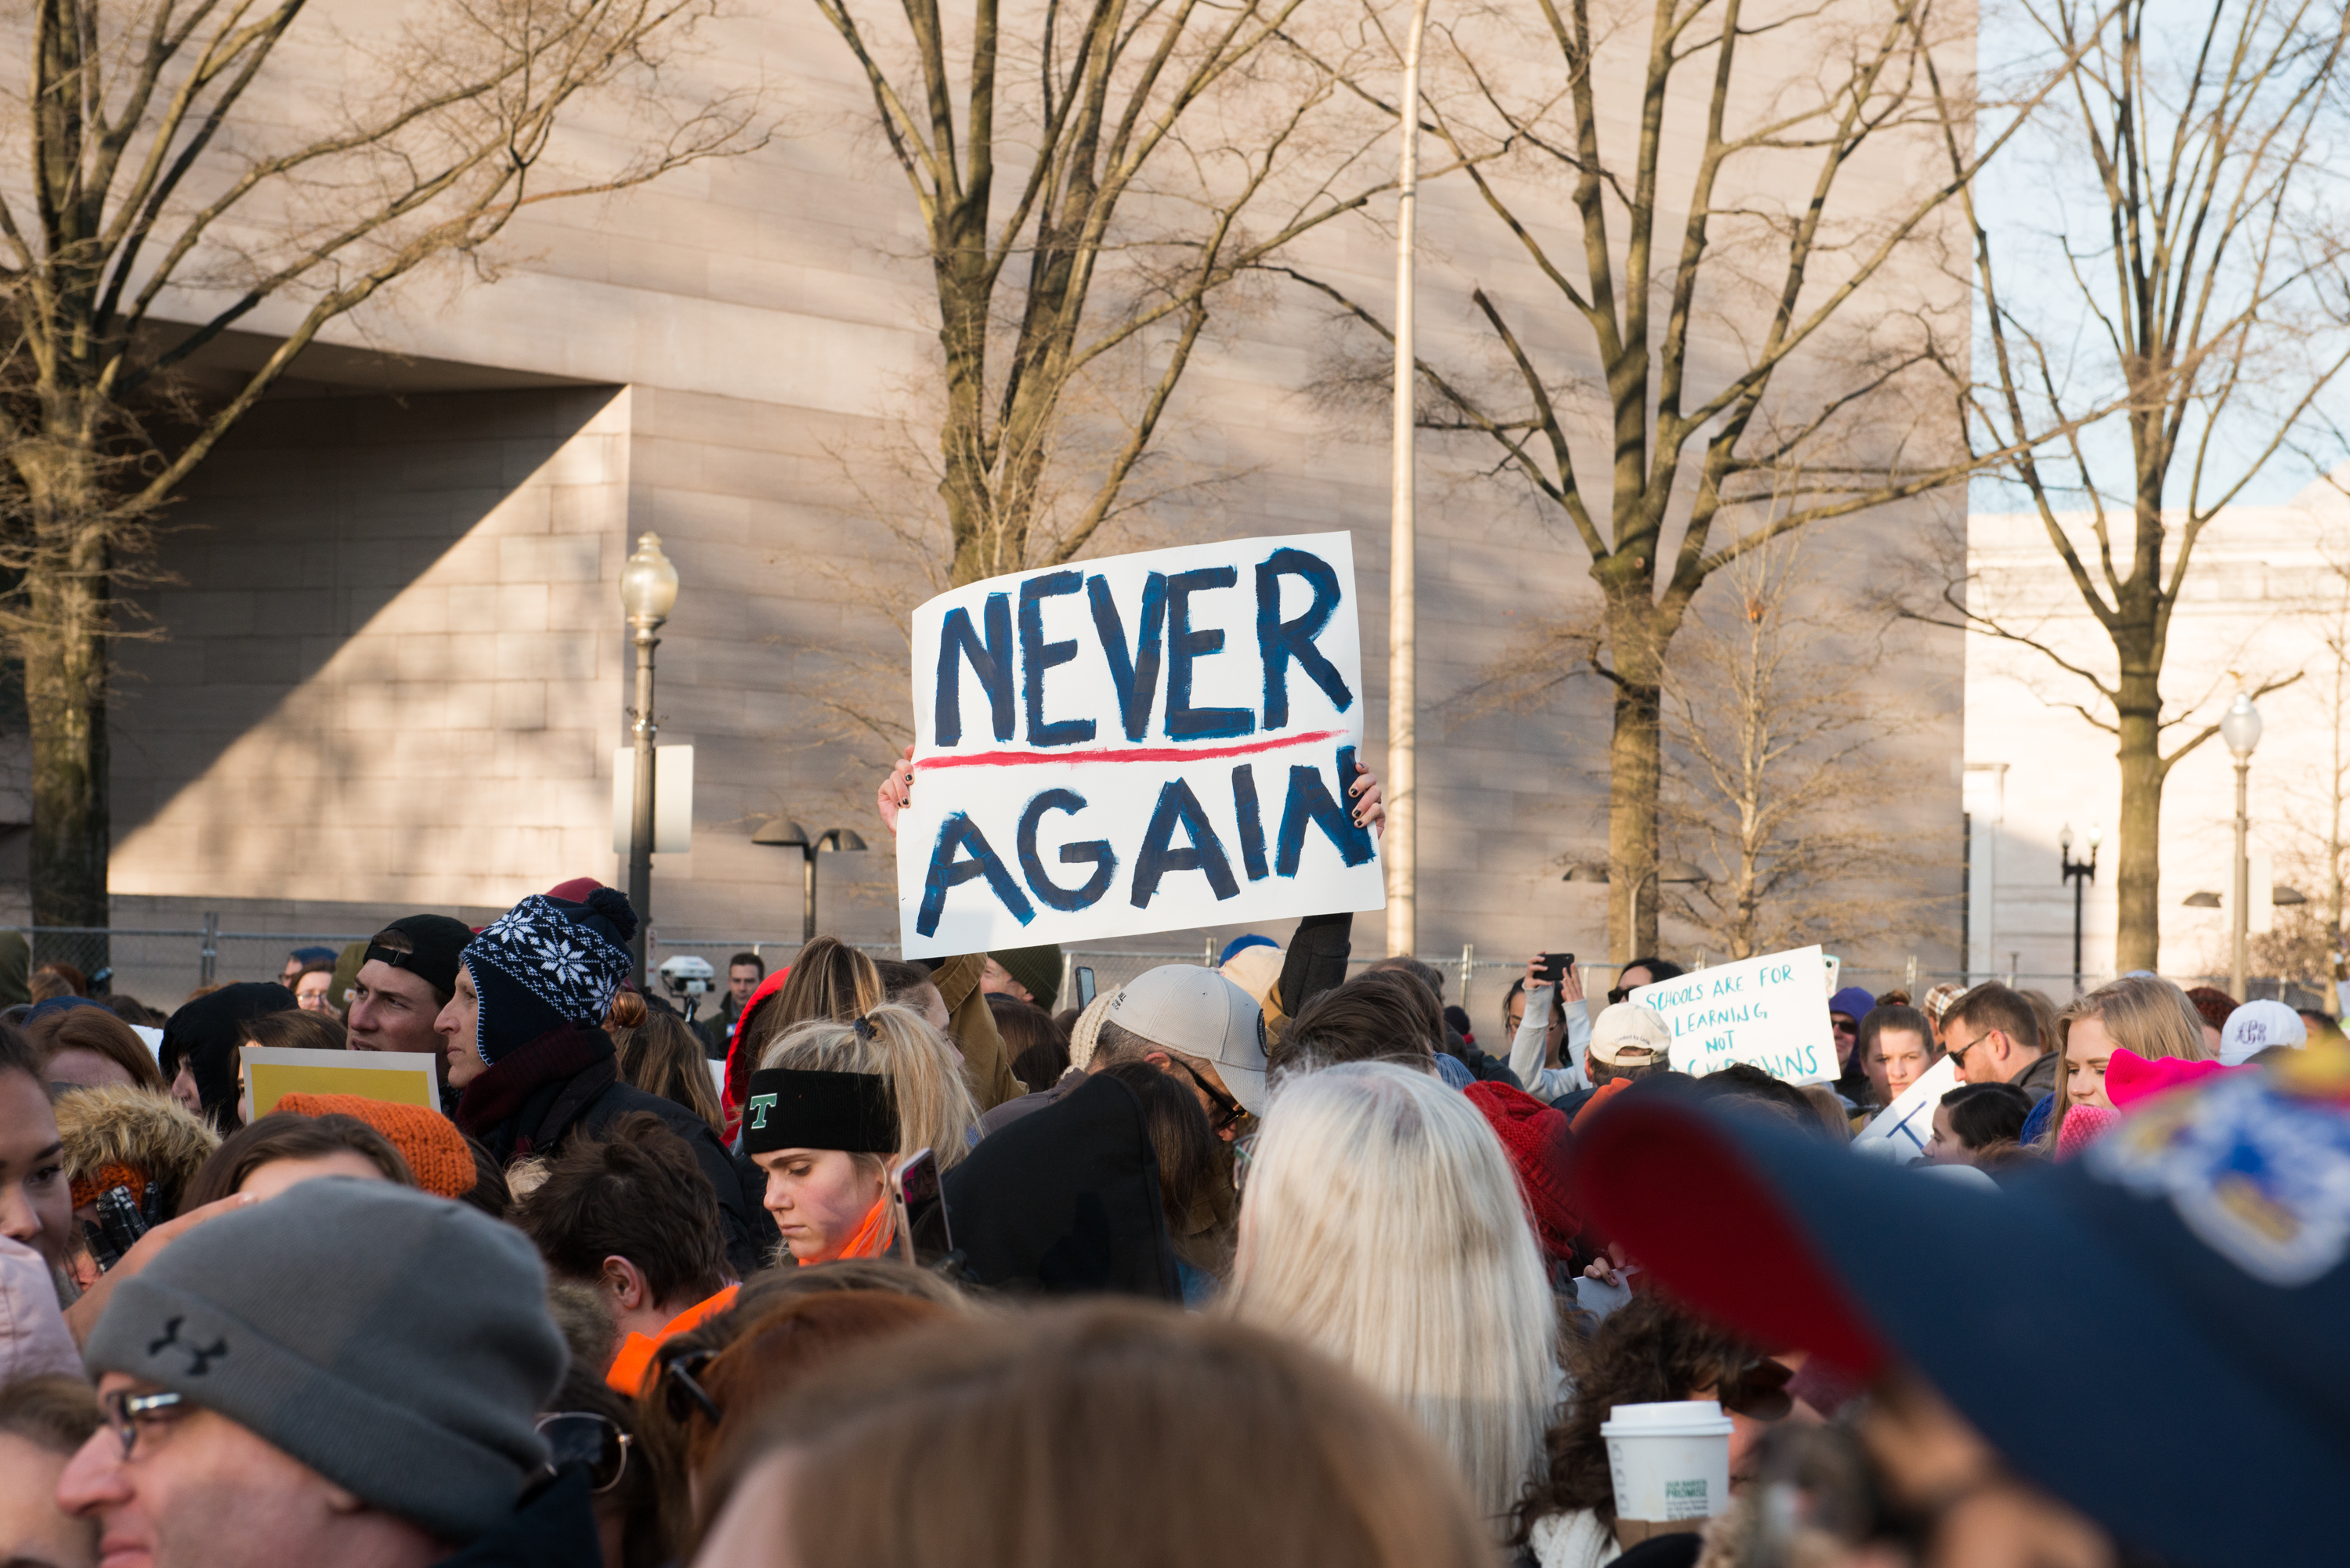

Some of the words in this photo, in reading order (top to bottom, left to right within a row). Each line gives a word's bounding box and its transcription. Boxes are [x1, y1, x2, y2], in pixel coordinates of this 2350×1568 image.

[935, 547, 1354, 747] NEVER
[915, 746, 1376, 938] AGAIN
[1646, 984, 1704, 1012] SCHOOLS
[1712, 976, 1744, 998] ARE
[1759, 964, 1795, 988] FOR
[1675, 1002, 1768, 1038] LEARNING
[1705, 1029, 1735, 1054] NOT
[749, 1092, 778, 1129] T
